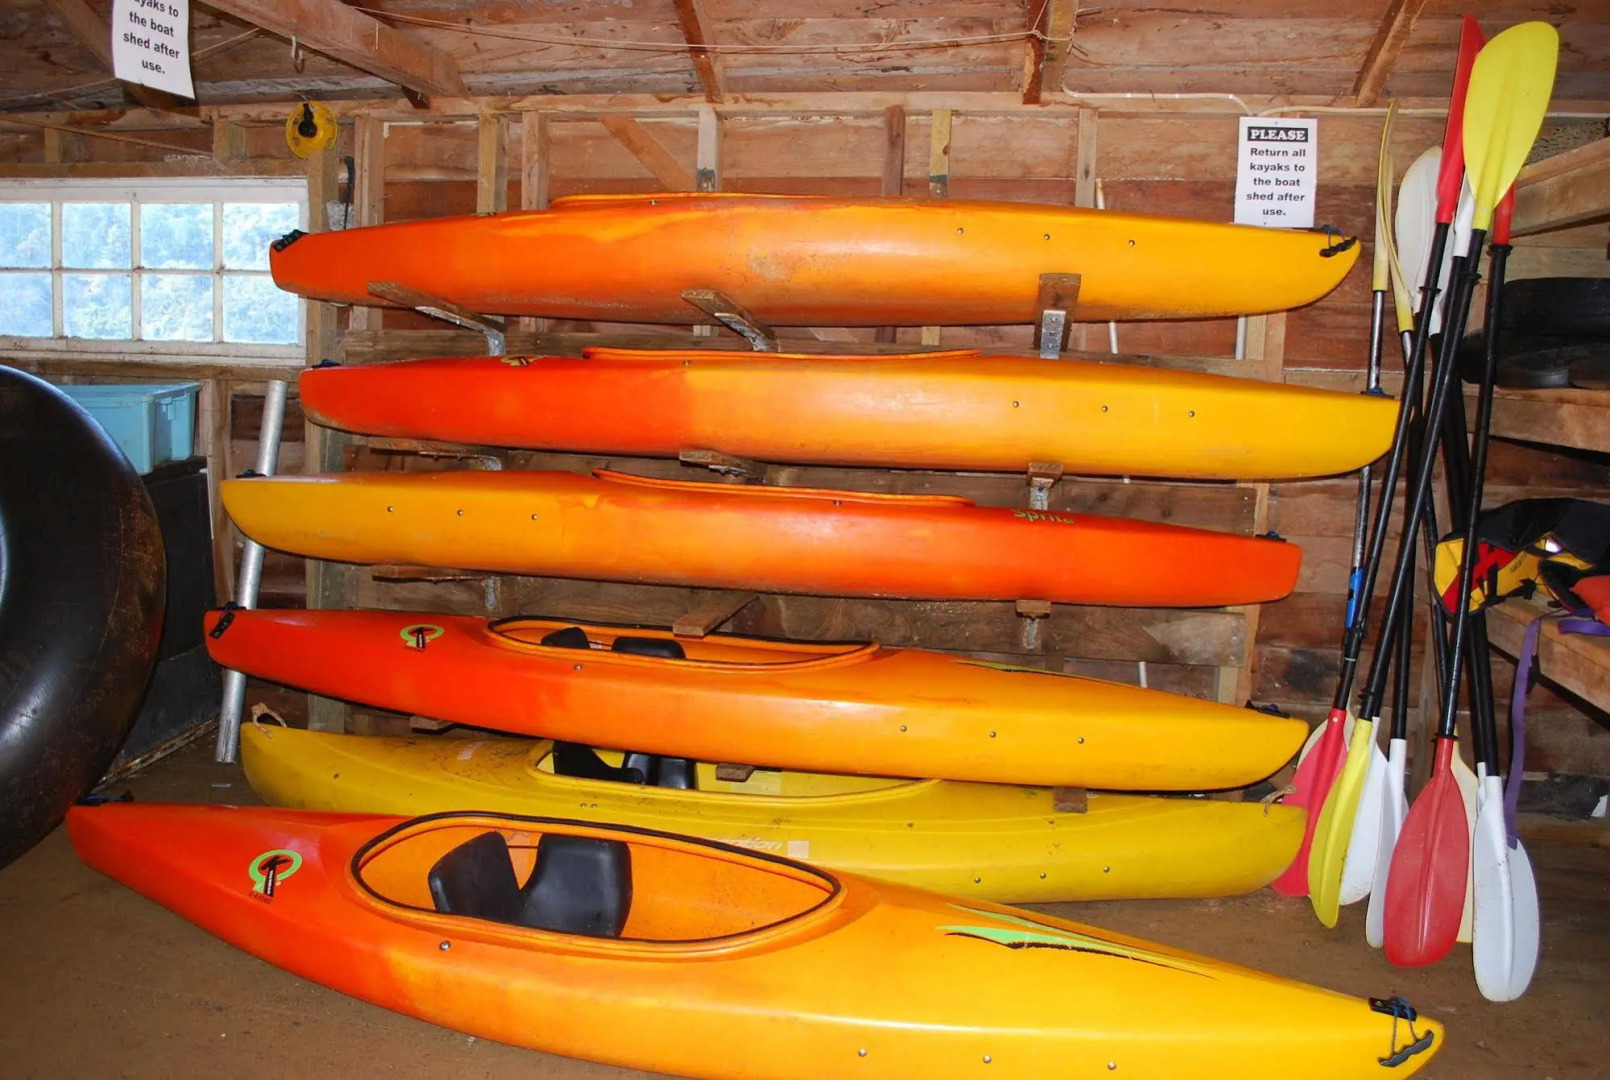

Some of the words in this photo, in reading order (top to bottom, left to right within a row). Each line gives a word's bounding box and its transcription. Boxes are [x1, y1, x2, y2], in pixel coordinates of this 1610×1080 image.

[168, 5, 179, 17] to
[129, 11, 147, 27] the
[150, 18, 174, 37] boat
[123, 32, 150, 49] shed
[153, 42, 180, 59] after
[141, 60, 166, 74] use.
[1250, 129, 1306, 141] PLEASE
[1250, 147, 1288, 157] Return
[1292, 148, 1306, 157] all
[1249, 162, 1290, 173] kayaks
[1294, 164, 1306, 172] to
[1253, 177, 1271, 186] the
[1275, 177, 1301, 187] boat
[1246, 192, 1274, 201] shed
[1277, 192, 1305, 202] after
[1262, 208, 1286, 216] use.
